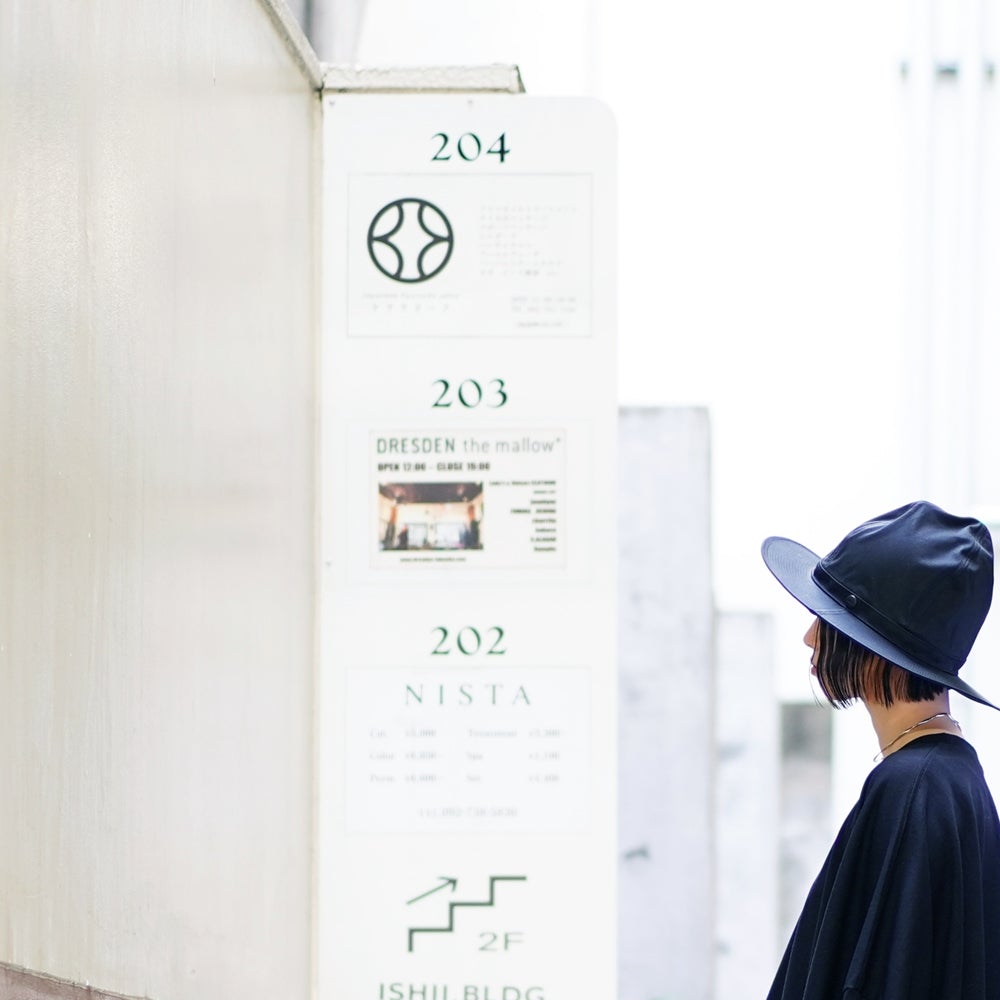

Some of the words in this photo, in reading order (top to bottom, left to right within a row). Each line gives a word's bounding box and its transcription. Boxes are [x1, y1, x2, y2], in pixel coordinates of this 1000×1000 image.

[431, 132, 511, 163] 204
[432, 379, 508, 408] 203
[377, 438, 455, 454] DRESDEN
[463, 438, 490, 454] the
[431, 626, 507, 656] 202
[405, 684, 531, 706] NISTA
[478, 932, 524, 951] 2F
